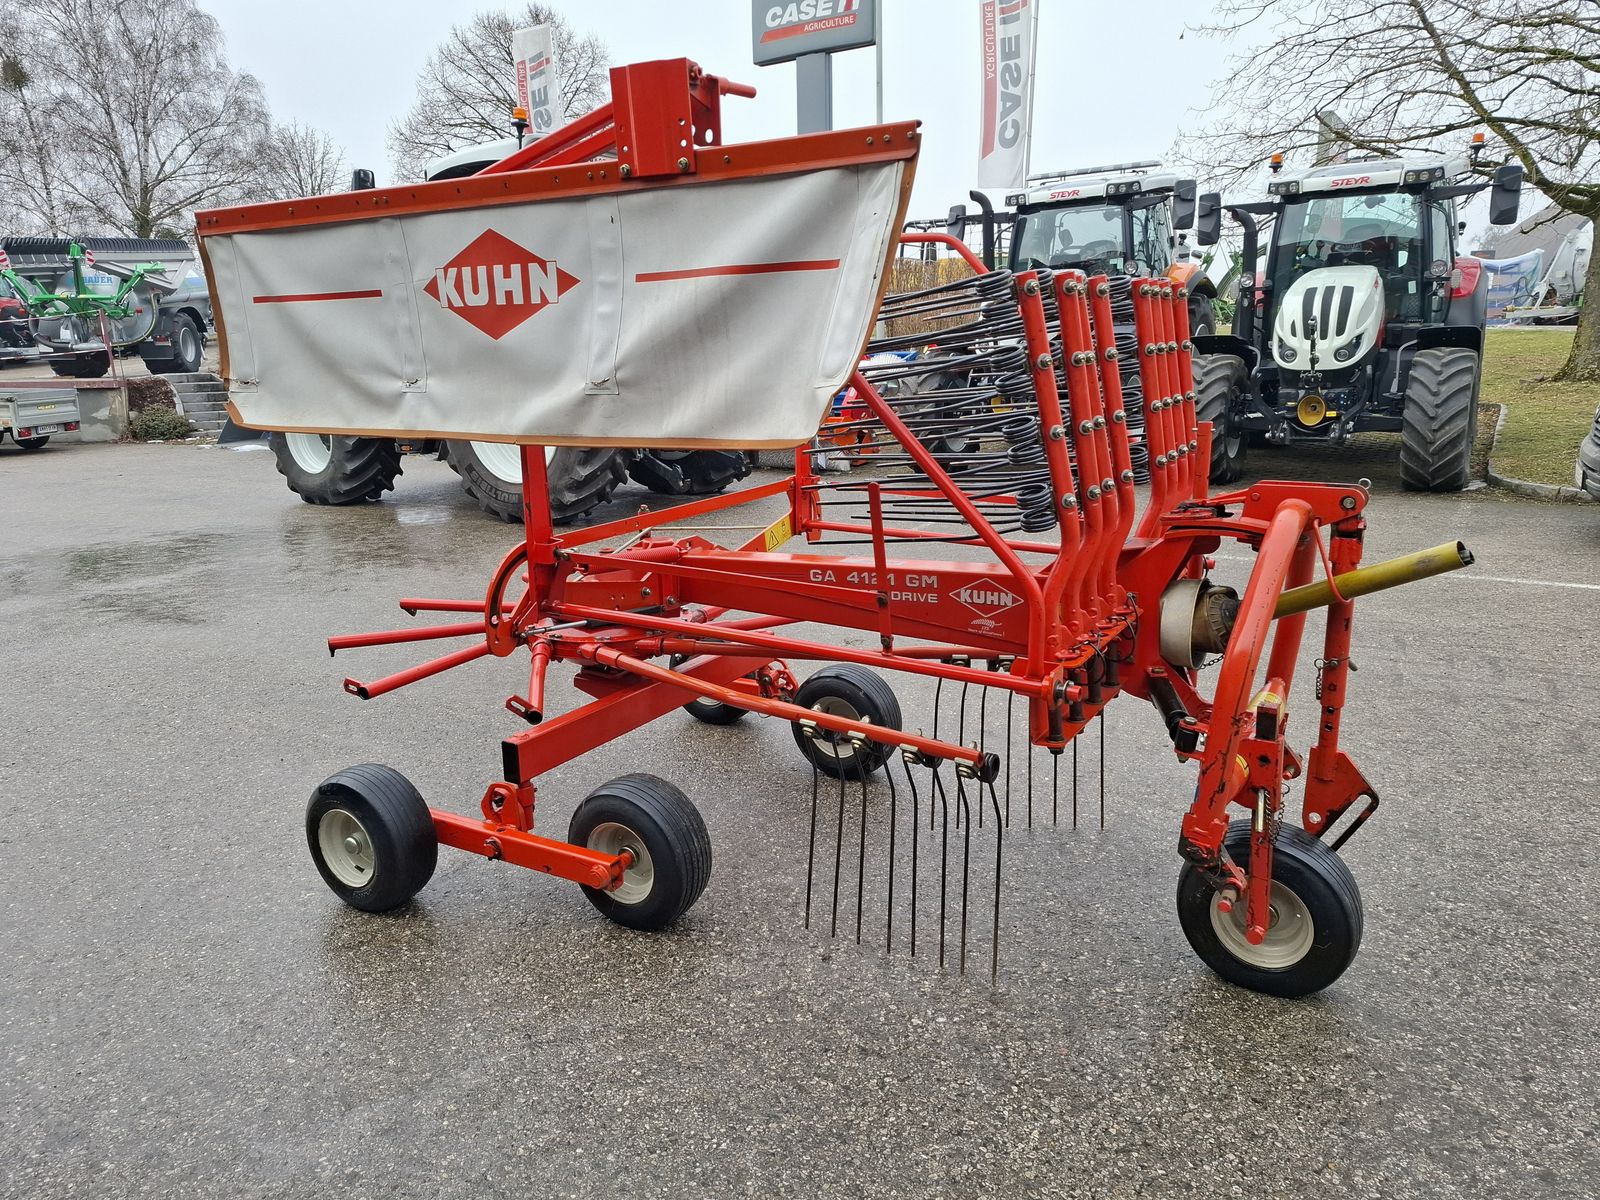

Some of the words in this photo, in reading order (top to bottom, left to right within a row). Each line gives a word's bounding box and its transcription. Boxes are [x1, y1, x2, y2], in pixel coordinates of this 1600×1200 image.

[765, 0, 832, 28] CASE
[804, 15, 854, 32] AGRICULTURE
[1330, 175, 1371, 188] STEYR
[1049, 189, 1080, 200] STEYR
[435, 260, 560, 309] KUHN
[809, 569, 836, 583] GA
[905, 574, 938, 589] GM
[960, 588, 1013, 608] KUHN
